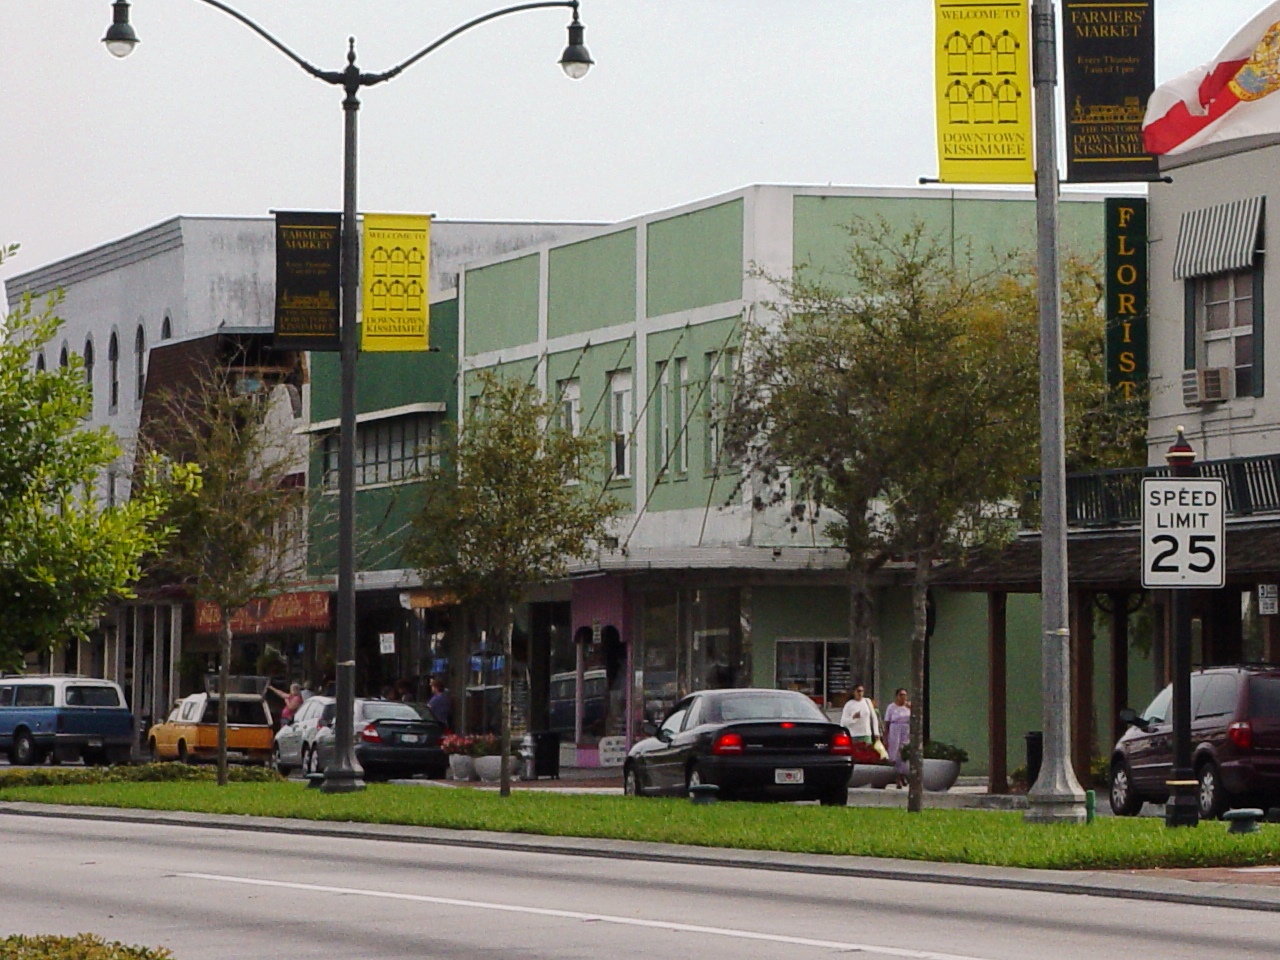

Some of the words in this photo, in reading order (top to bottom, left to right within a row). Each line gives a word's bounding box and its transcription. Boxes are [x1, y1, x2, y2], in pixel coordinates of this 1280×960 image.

[941, 10, 1001, 20] WELCOME
[1003, 10, 1021, 19] TO
[1072, 10, 1146, 23] FARMERS'
[1076, 25, 1141, 37] MARKET
[942, 133, 1025, 143] DOWNTOWN
[1074, 134, 1139, 144] DOWNTOW
[943, 143, 1026, 155] KISSIMMEE
[1074, 143, 1147, 155] KISSIMME
[1117, 207, 1137, 402] FLORIST
[1150, 490, 1217, 506] SPEED
[1157, 512, 1209, 528] LIMIT
[1151, 535, 1216, 573] 25
